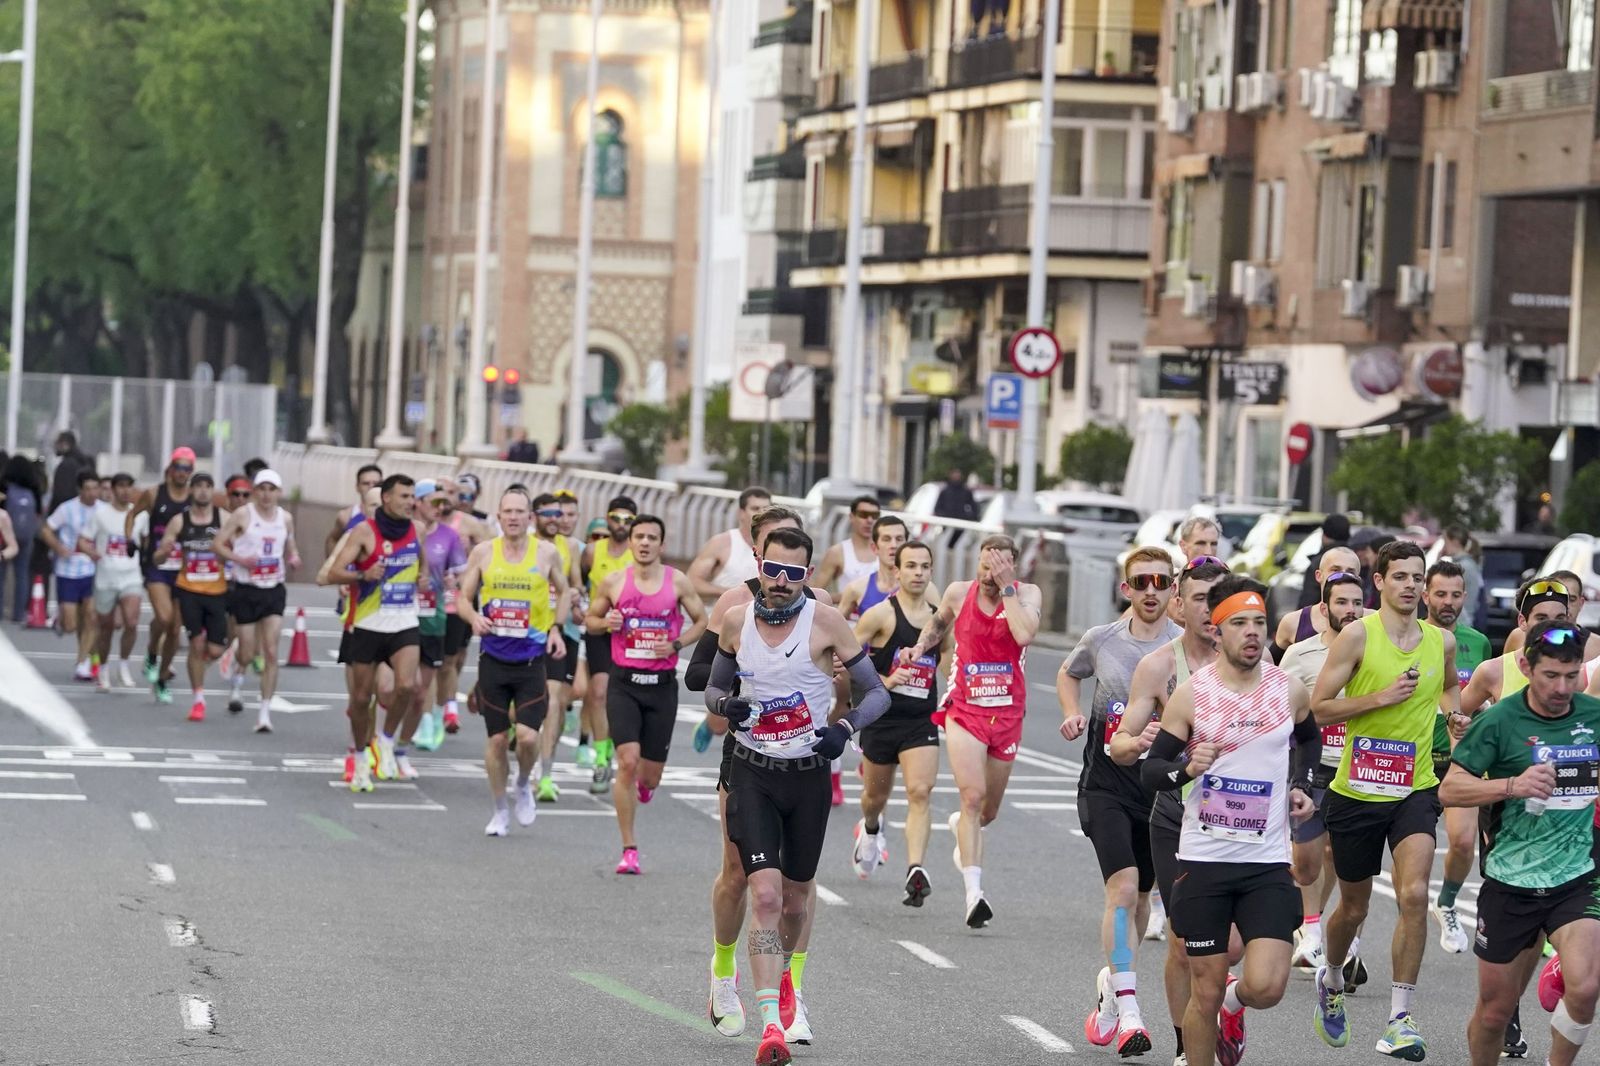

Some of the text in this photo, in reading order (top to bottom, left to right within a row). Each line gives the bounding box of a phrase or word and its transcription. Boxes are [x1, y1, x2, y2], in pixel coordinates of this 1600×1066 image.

[991, 379, 1016, 410] P
[493, 583, 532, 591] STRIDERS
[641, 620, 666, 628] ZURICH
[634, 639, 655, 649] DAVI
[970, 685, 1008, 697] THOMAS
[766, 696, 798, 711] ZURICH
[774, 714, 789, 724] 958
[753, 723, 813, 741] DAVID PSICORUN
[1375, 742, 1410, 753] ZURICH
[1557, 748, 1593, 759] ZURICH
[1374, 758, 1393, 768] 1297
[1357, 767, 1407, 784] VINCENT
[1557, 768, 1578, 778] 3680
[1226, 781, 1265, 793] ZURICH
[1552, 785, 1600, 796] OS CALDERA
[1225, 800, 1246, 811] 9990
[1233, 817, 1267, 829] GOMEZ
[1189, 940, 1215, 948] TERREX
